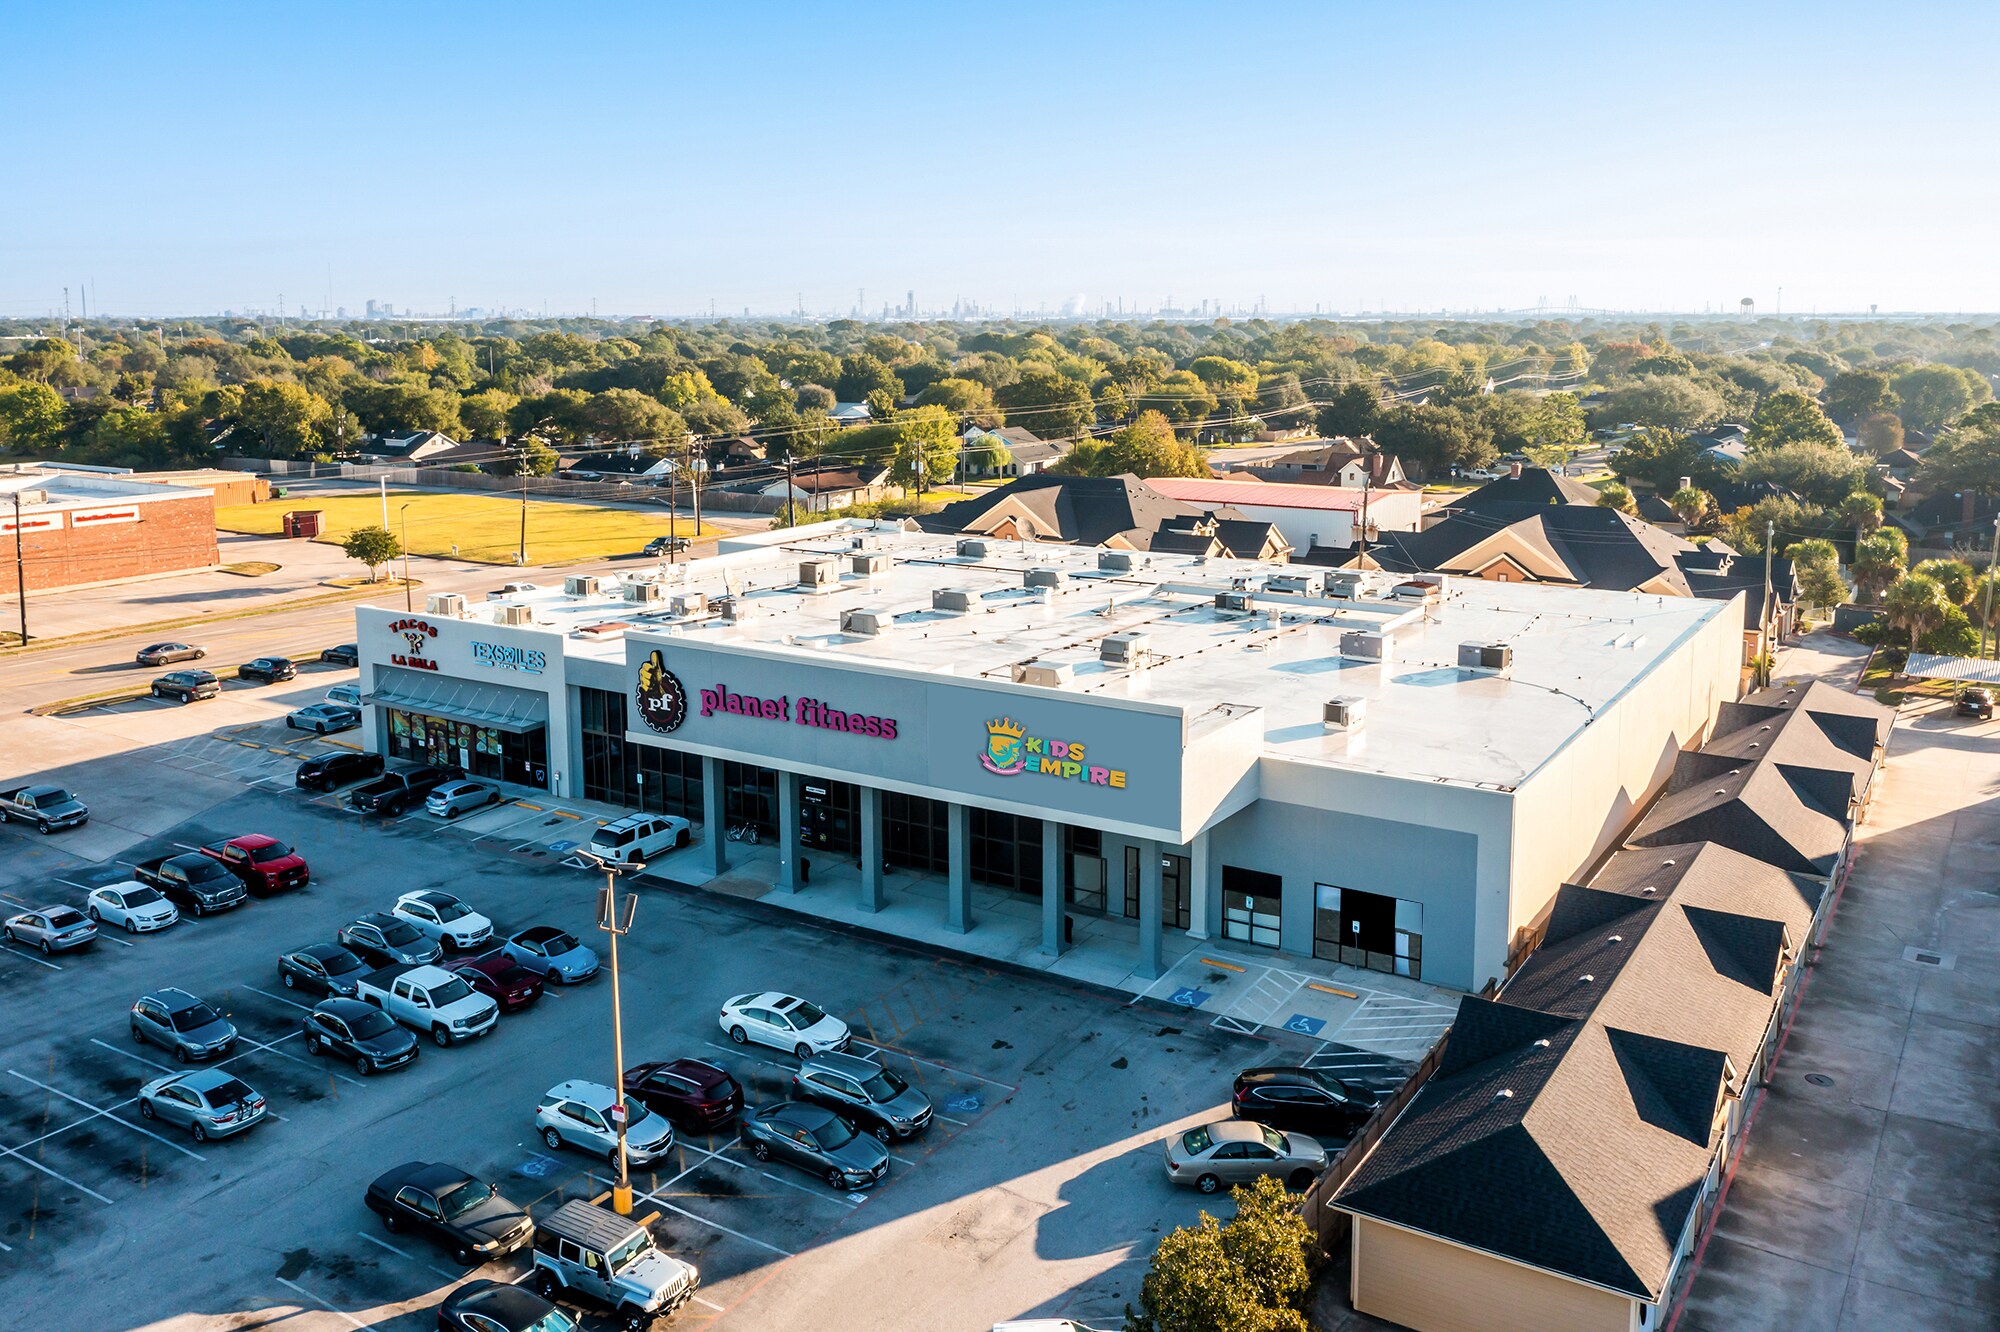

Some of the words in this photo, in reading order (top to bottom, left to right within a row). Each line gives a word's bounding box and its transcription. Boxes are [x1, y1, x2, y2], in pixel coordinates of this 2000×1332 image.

[388, 619, 438, 638] TACOS
[391, 653, 407, 666] LA
[648, 693, 674, 712] pf
[700, 684, 789, 722] planet
[795, 697, 898, 740] fitness
[1026, 736, 1085, 762] KIDS
[1025, 755, 1126, 789] EMPIRE
